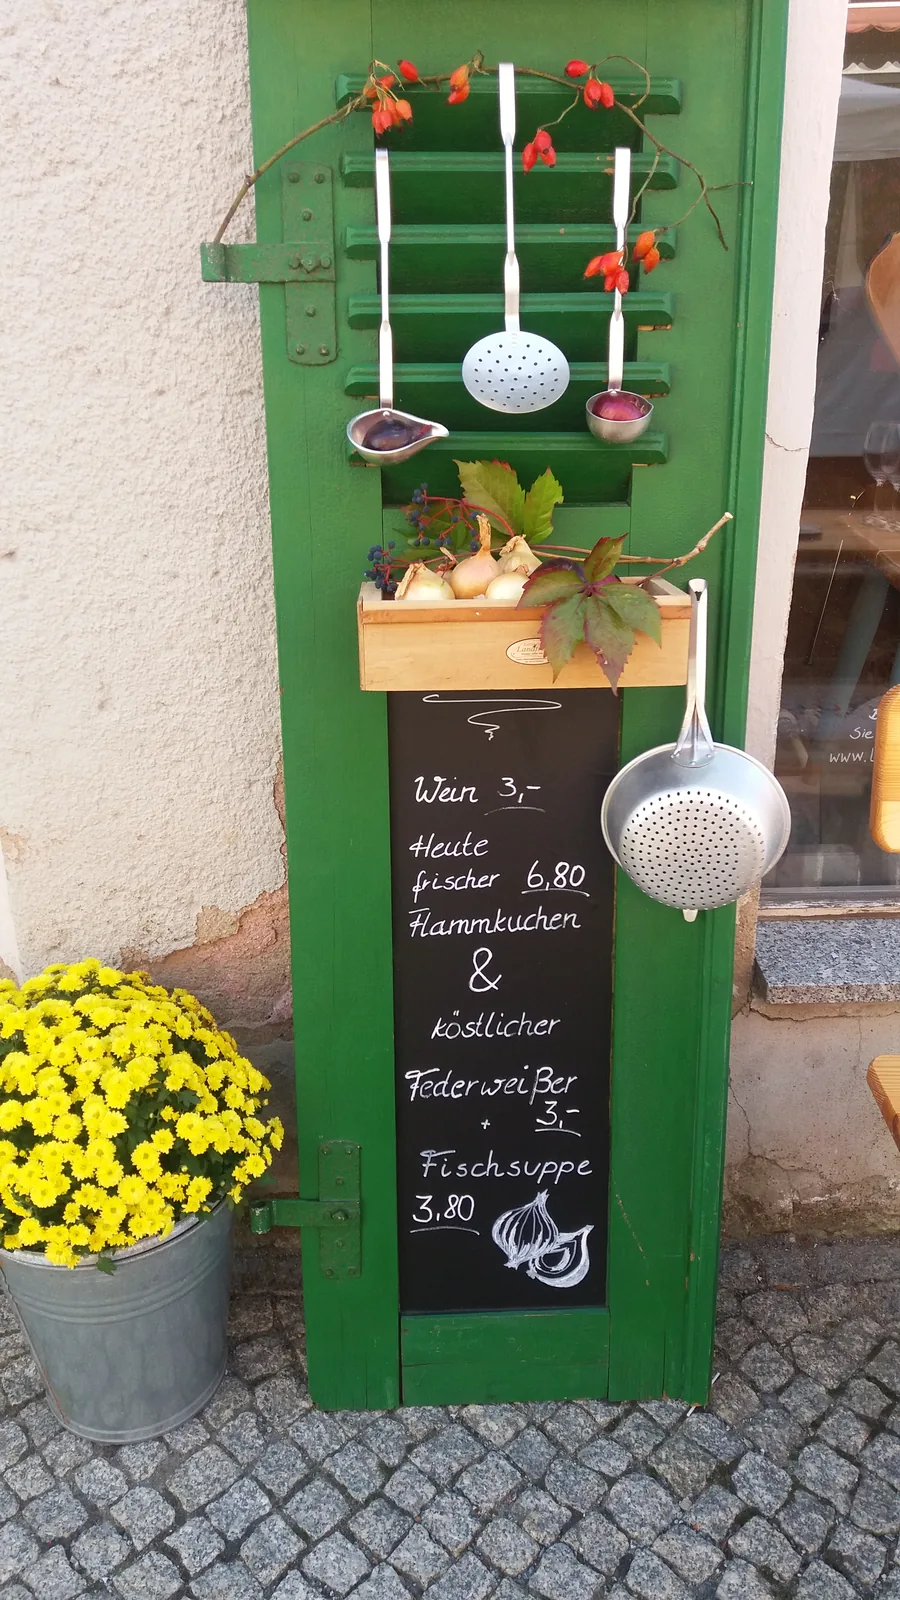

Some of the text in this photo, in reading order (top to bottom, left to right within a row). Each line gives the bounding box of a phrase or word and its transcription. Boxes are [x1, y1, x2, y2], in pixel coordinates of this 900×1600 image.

[829, 747, 874, 763] www.l
[413, 776, 479, 803] Wein
[408, 831, 489, 859] Heute
[412, 860, 586, 904] frischer 6,80
[408, 905, 582, 938] Flammkuchen
[468, 947, 502, 993] &
[430, 1009, 561, 1040] köstlicher
[404, 1064, 578, 1106] Federweißer
[480, 1118, 491, 1130] +
[419, 1149, 593, 1185] Fischsuppe
[412, 1194, 475, 1223] 3,80
